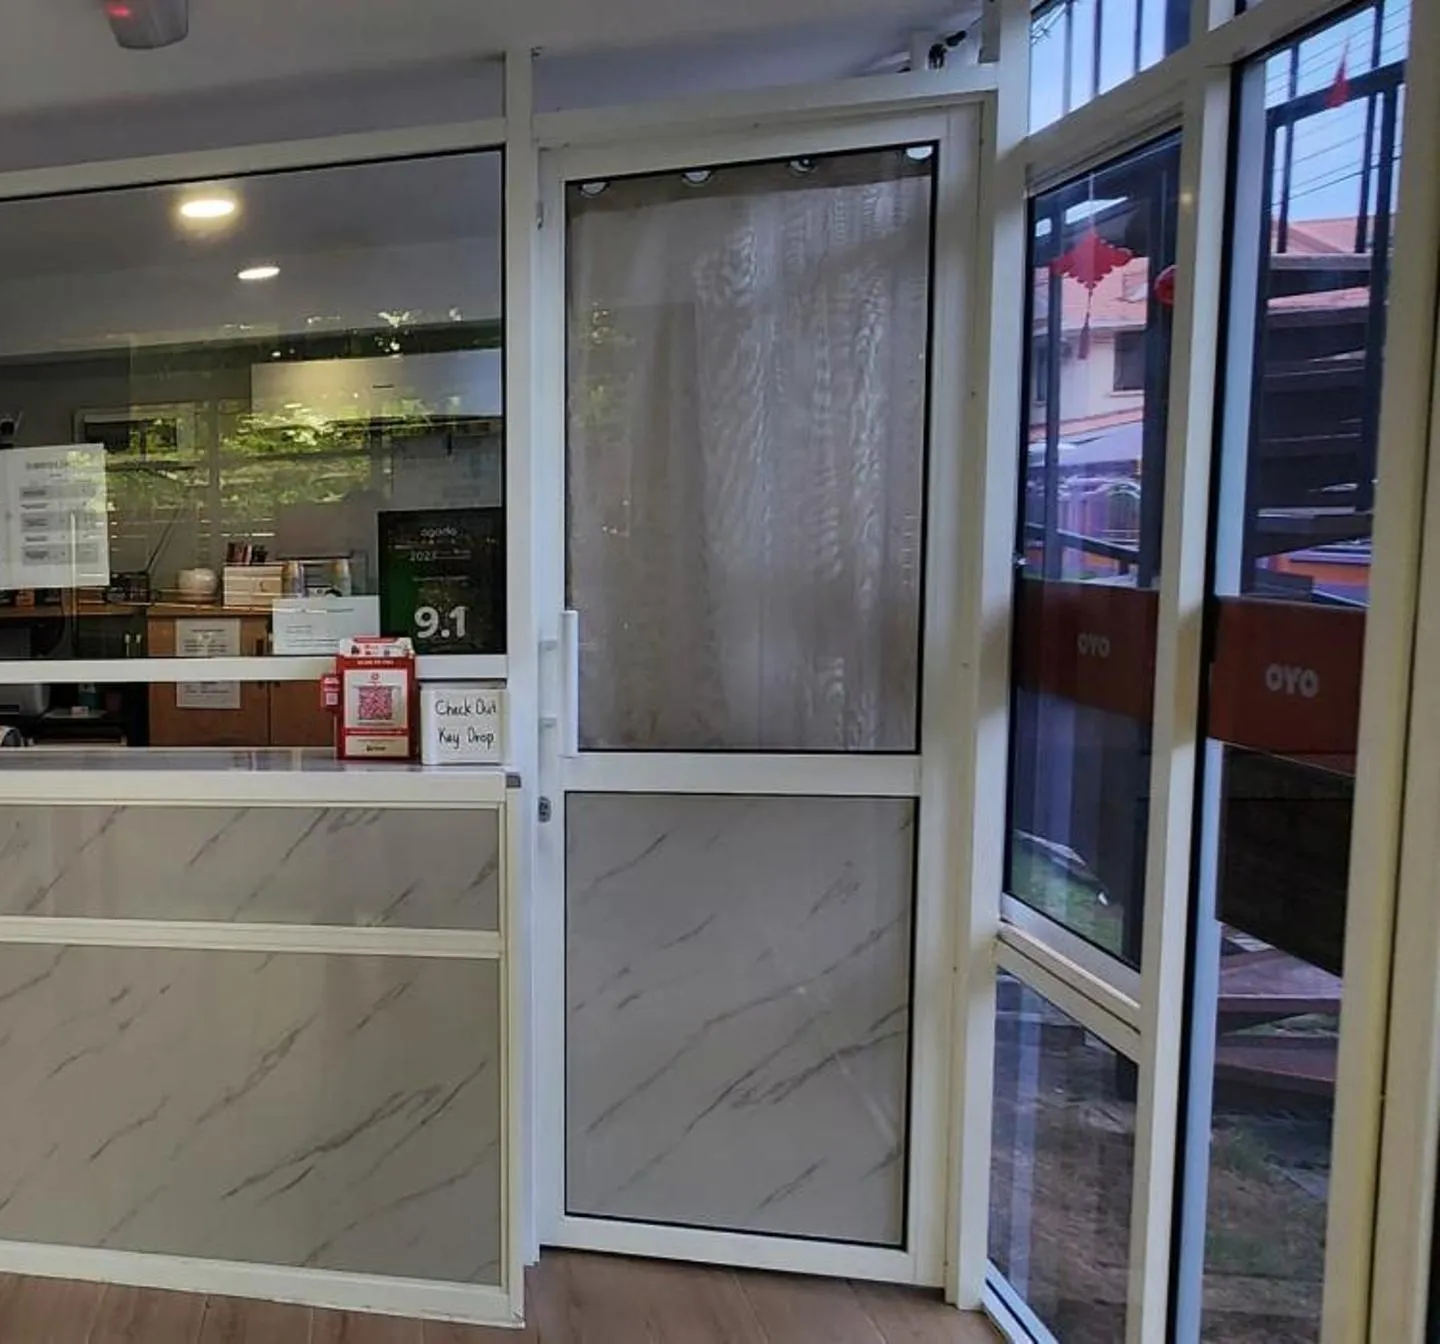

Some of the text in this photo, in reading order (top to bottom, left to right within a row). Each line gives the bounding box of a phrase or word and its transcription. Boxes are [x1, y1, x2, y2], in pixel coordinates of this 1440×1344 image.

[414, 606, 467, 638] 9.1
[1077, 632, 1111, 658] OYO
[1266, 663, 1320, 698] OYO
[435, 696, 471, 716] Check
[438, 726, 495, 750] Key Drop
